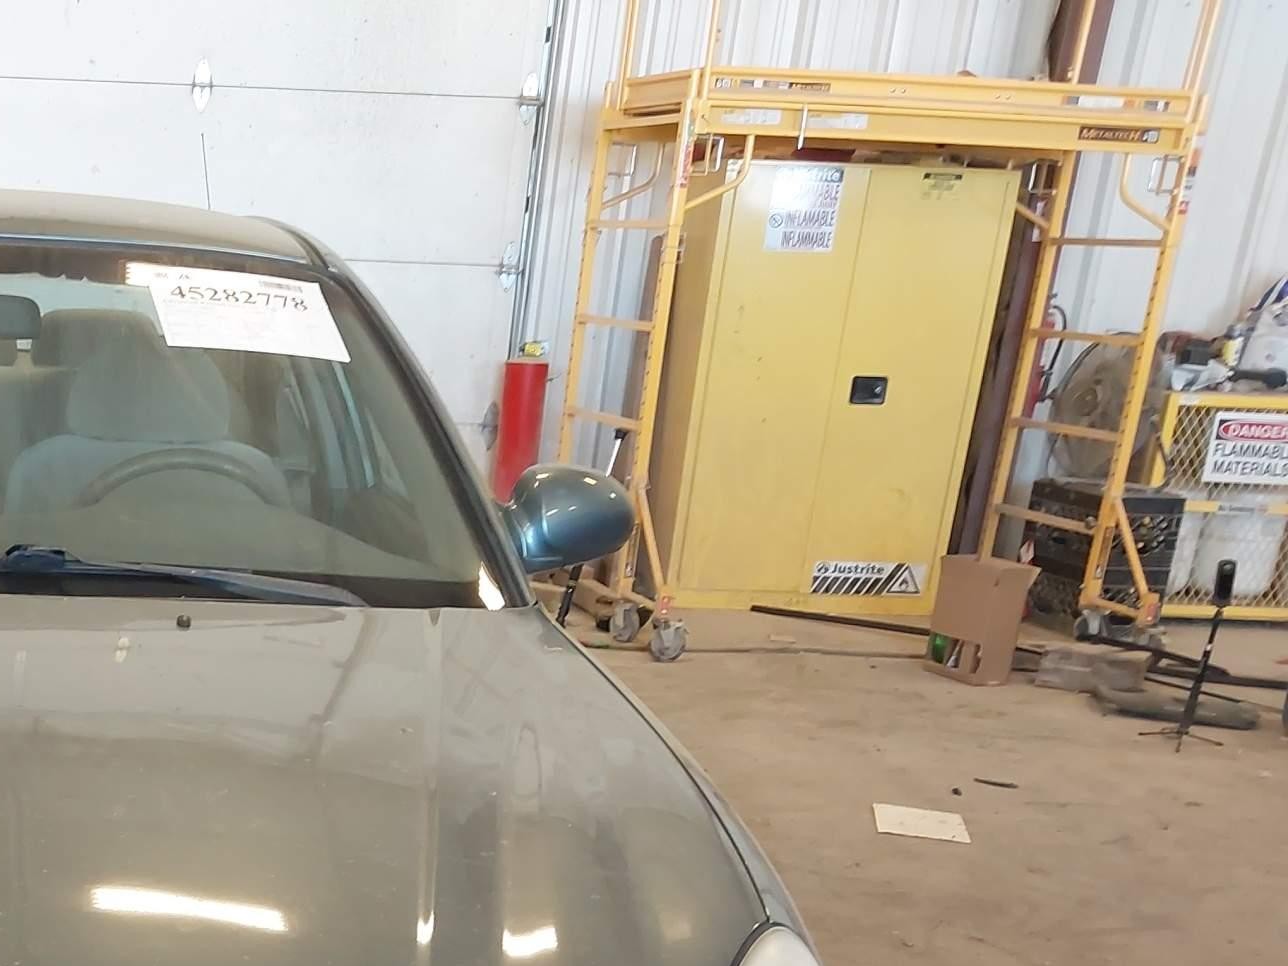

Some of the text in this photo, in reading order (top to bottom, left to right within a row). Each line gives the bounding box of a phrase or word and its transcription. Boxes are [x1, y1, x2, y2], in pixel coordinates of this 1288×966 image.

[785, 209, 836, 227] INFLAMABLE
[781, 231, 834, 248] INFLAMMABLE
[170, 285, 309, 312] 45282778
[1213, 442, 1288, 460] FLAMMABL
[830, 562, 885, 575] Justrite
